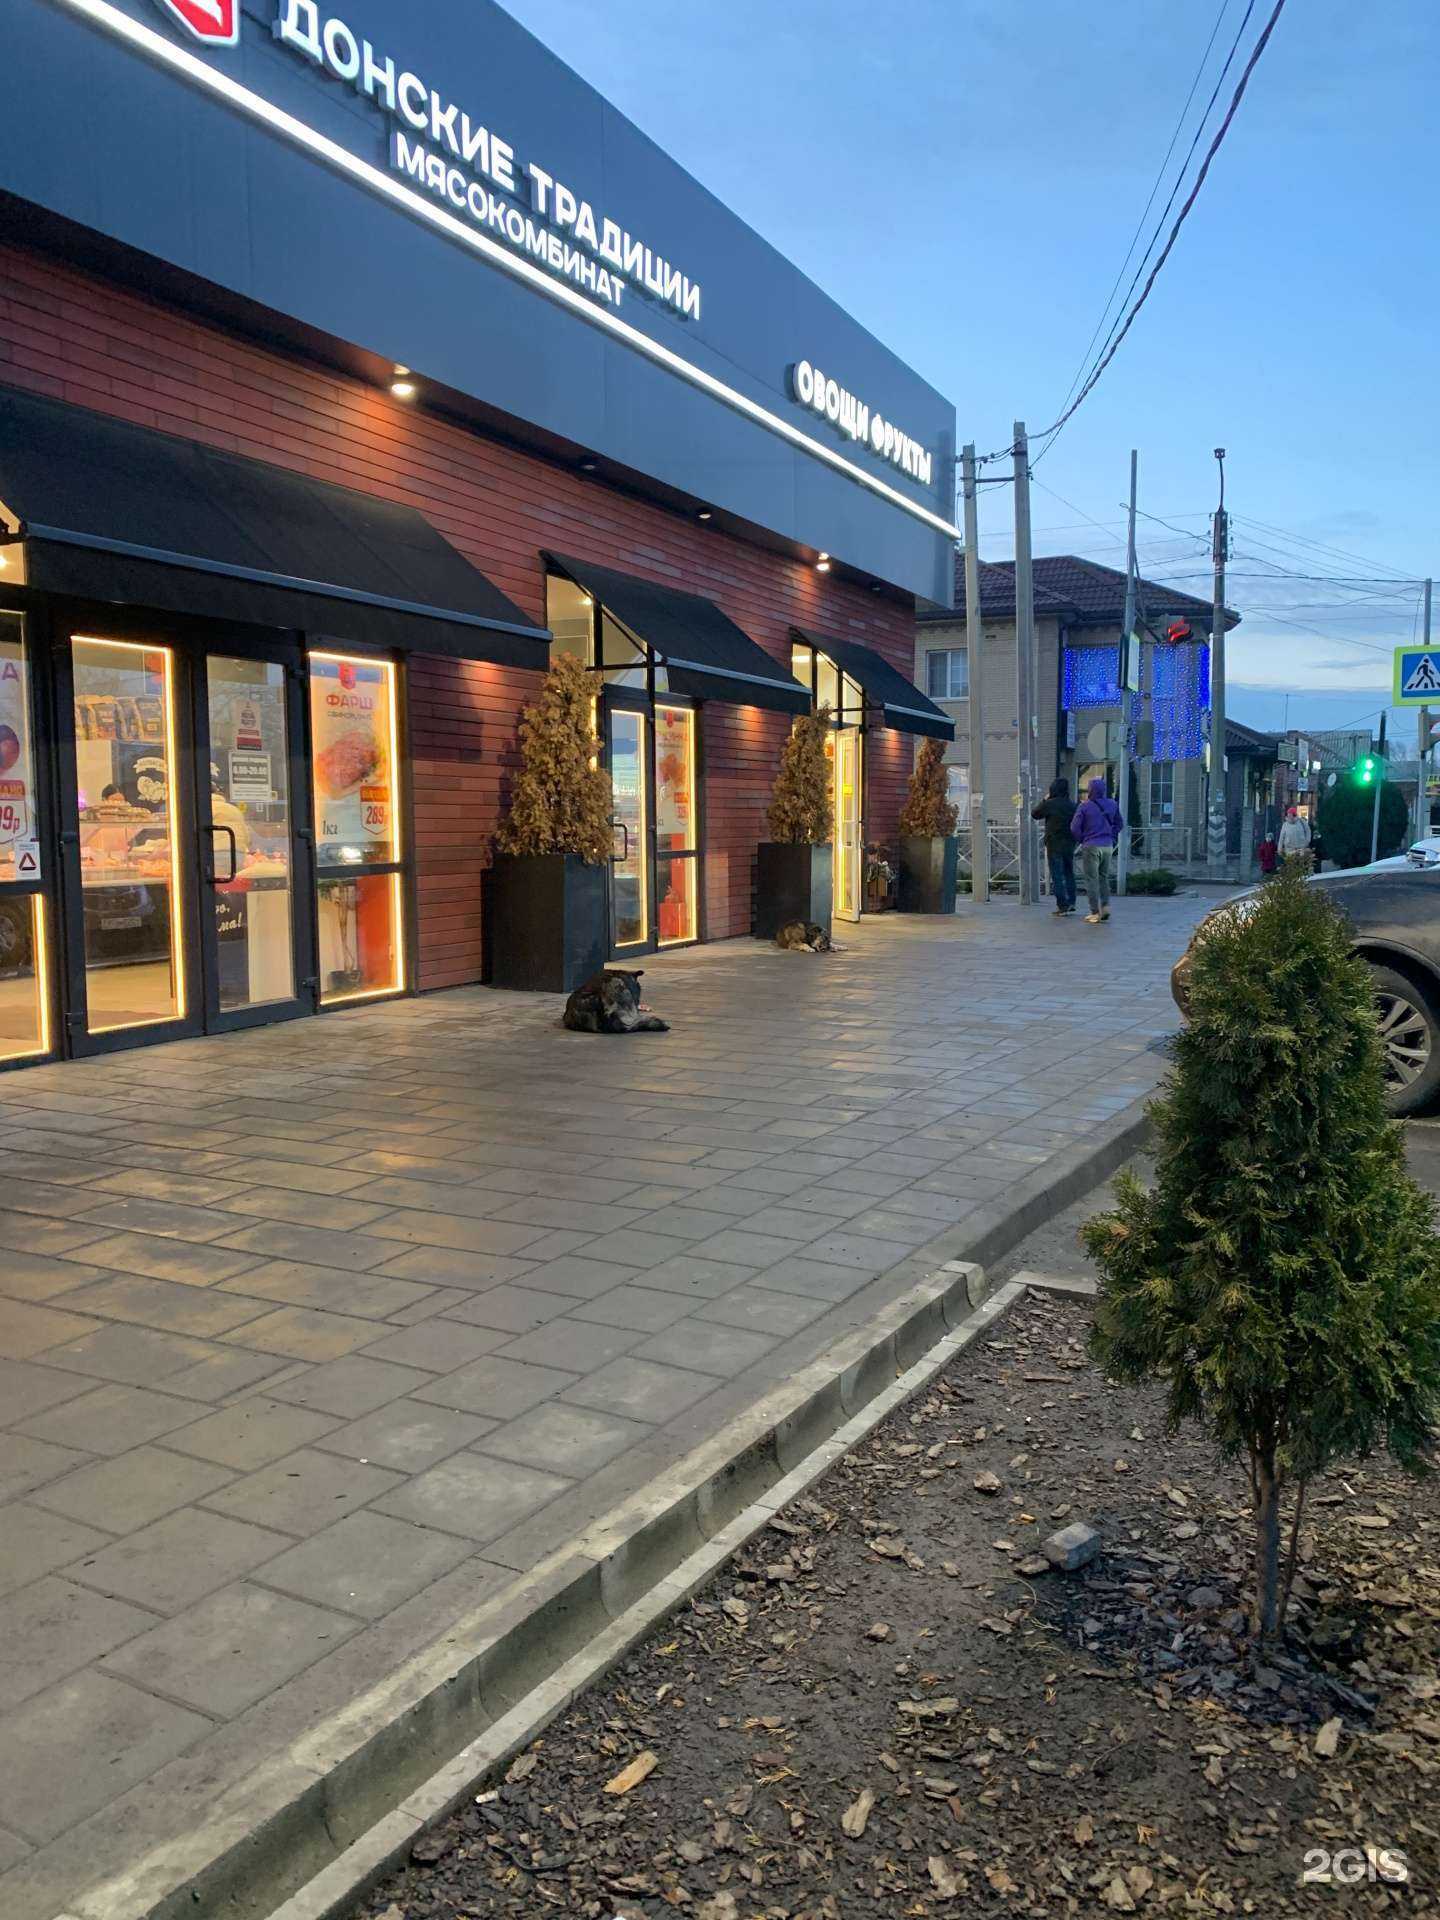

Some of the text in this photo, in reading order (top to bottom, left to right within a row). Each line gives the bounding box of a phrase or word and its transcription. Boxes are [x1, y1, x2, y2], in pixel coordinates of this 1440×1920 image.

[280, 0, 700, 321] ДОНСКИЕ ТРАДИЦИИ
[396, 132, 625, 306] МЯСОКОМБИНАТ
[796, 360, 932, 485] ОВОЩИ ФРУКТЫ
[326, 694, 373, 710] ФАРШ
[366, 805, 385, 825] 289
